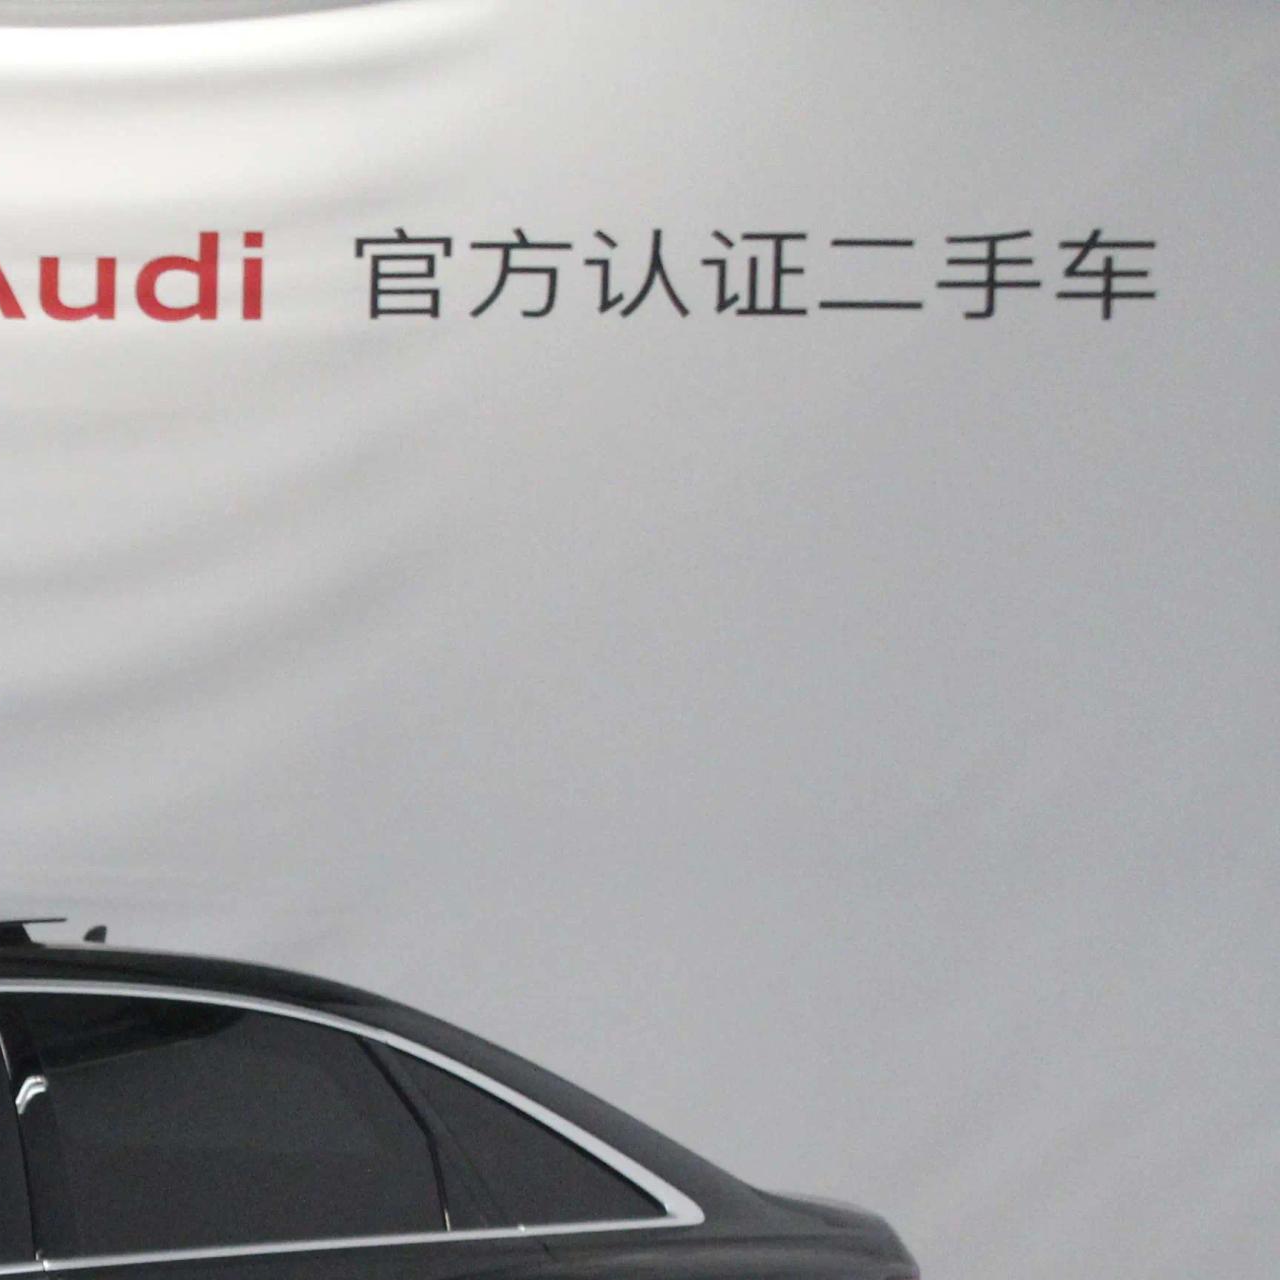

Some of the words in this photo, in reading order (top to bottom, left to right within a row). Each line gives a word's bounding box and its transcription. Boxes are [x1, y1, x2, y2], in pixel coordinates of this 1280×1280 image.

[355, 228, 1157, 321] 官方认证二手车
